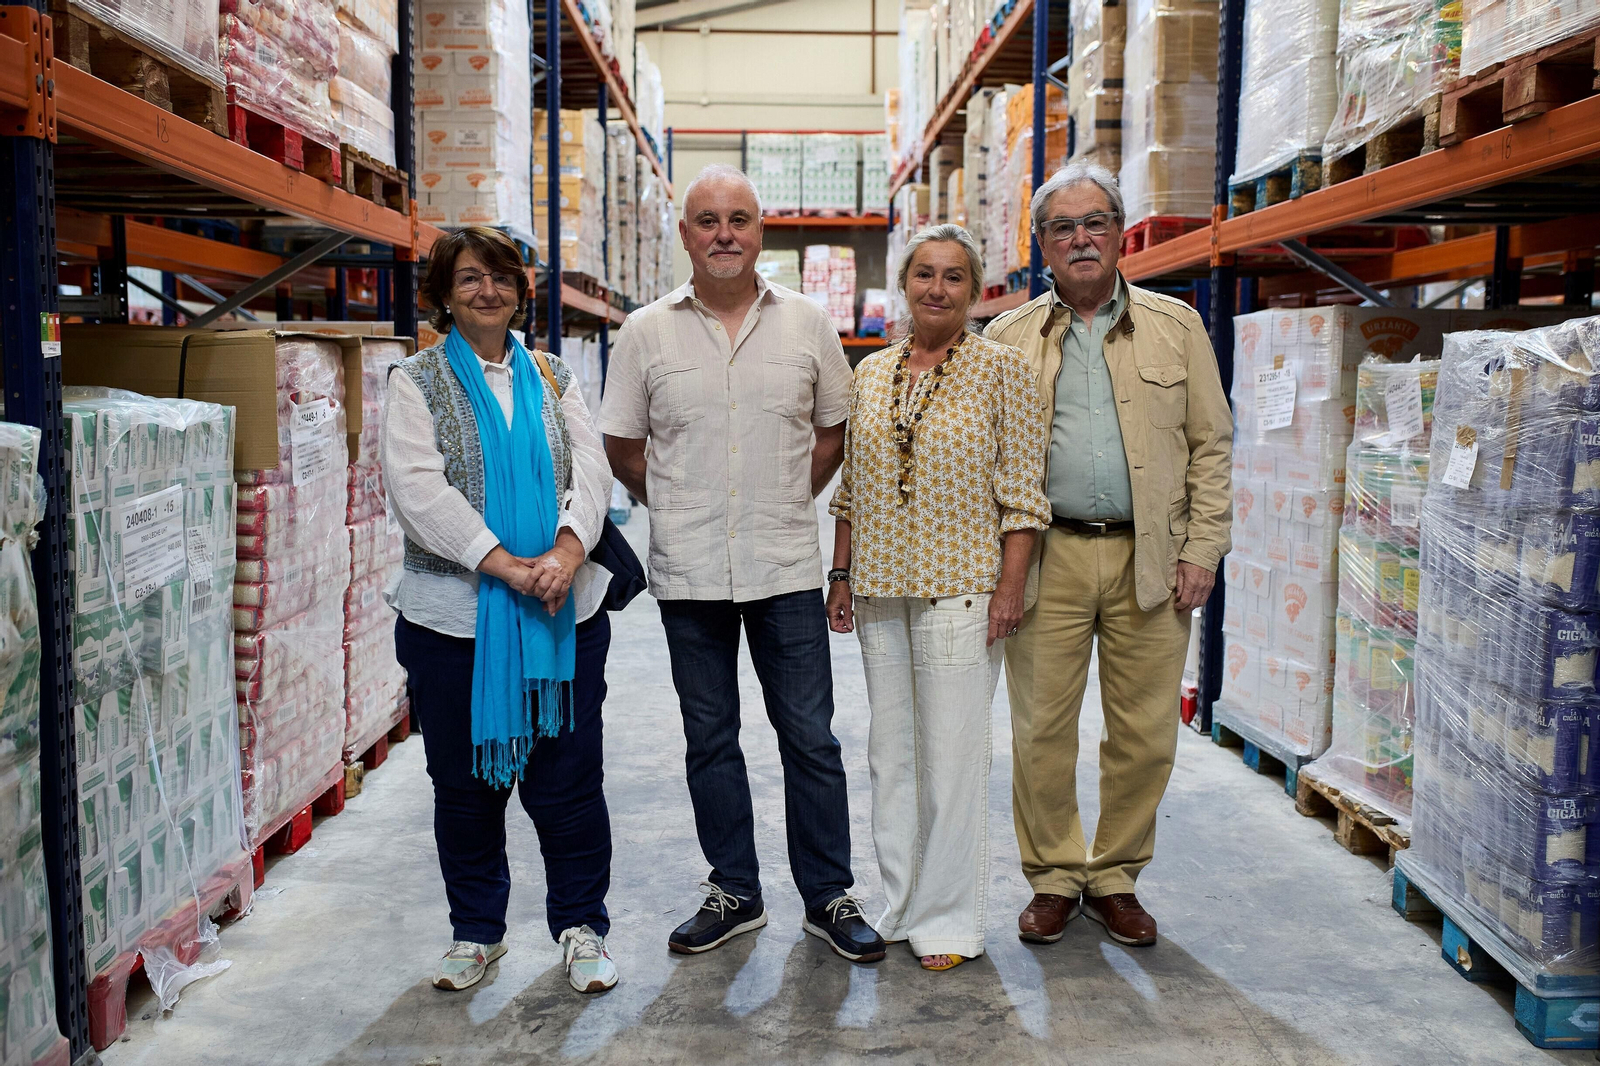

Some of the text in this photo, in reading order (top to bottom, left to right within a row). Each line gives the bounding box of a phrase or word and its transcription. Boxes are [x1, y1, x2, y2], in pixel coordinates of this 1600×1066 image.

[156, 113, 170, 144] 18
[1501, 133, 1513, 160] 18
[1366, 320, 1413, 337] URZANTE
[125, 499, 174, 529] 240408-1 -15
[1574, 621, 1587, 630] LA
[1557, 629, 1598, 641] CIGALA
[1563, 799, 1577, 809] LA
[1546, 808, 1588, 819] CIGALA
